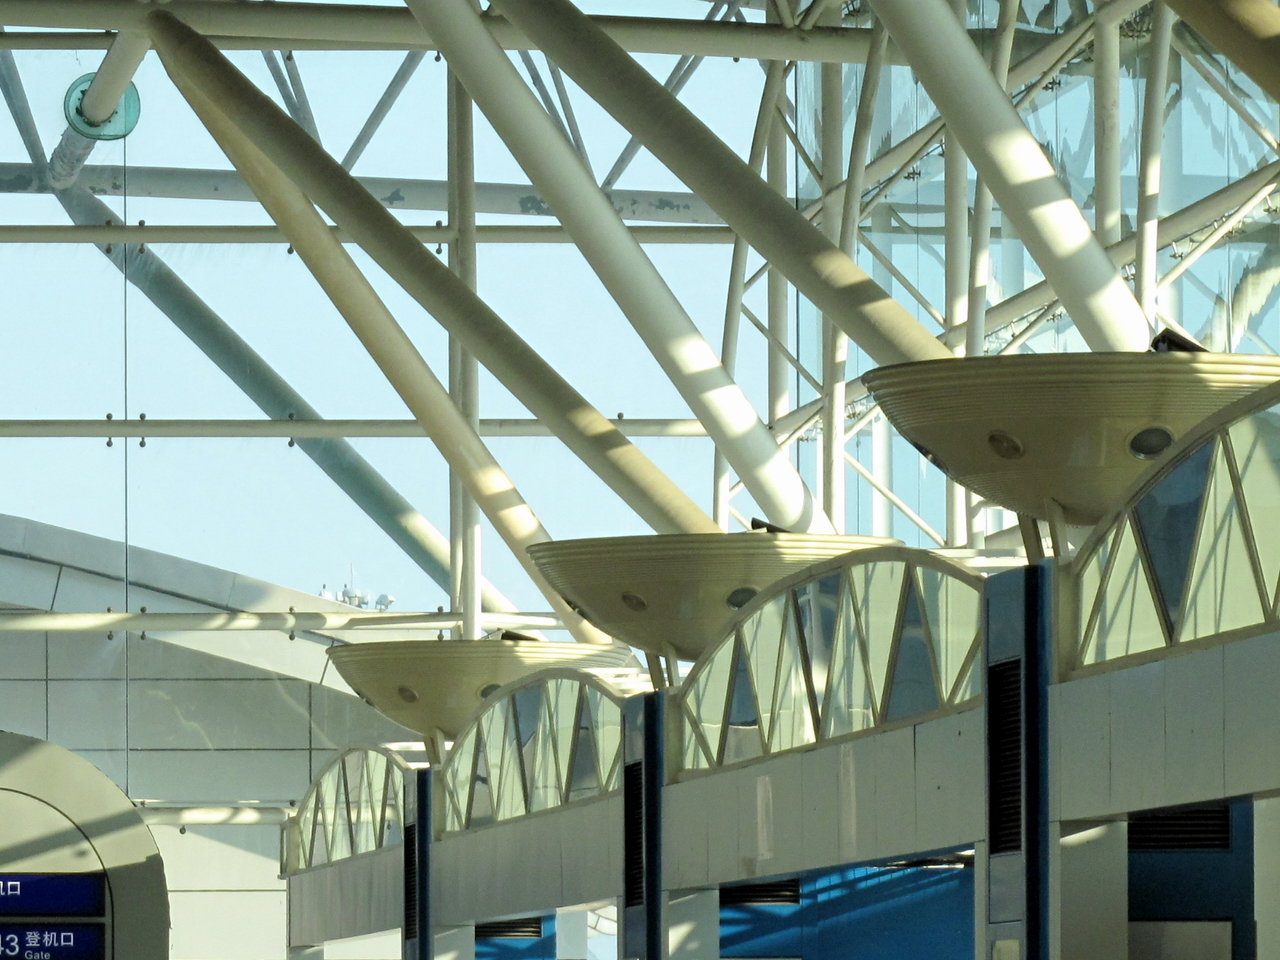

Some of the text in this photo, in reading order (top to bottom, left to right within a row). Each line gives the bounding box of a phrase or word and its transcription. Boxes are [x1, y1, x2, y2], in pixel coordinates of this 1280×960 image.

[25, 931, 74, 947] 登机口
[24, 950, 51, 960] Gate
